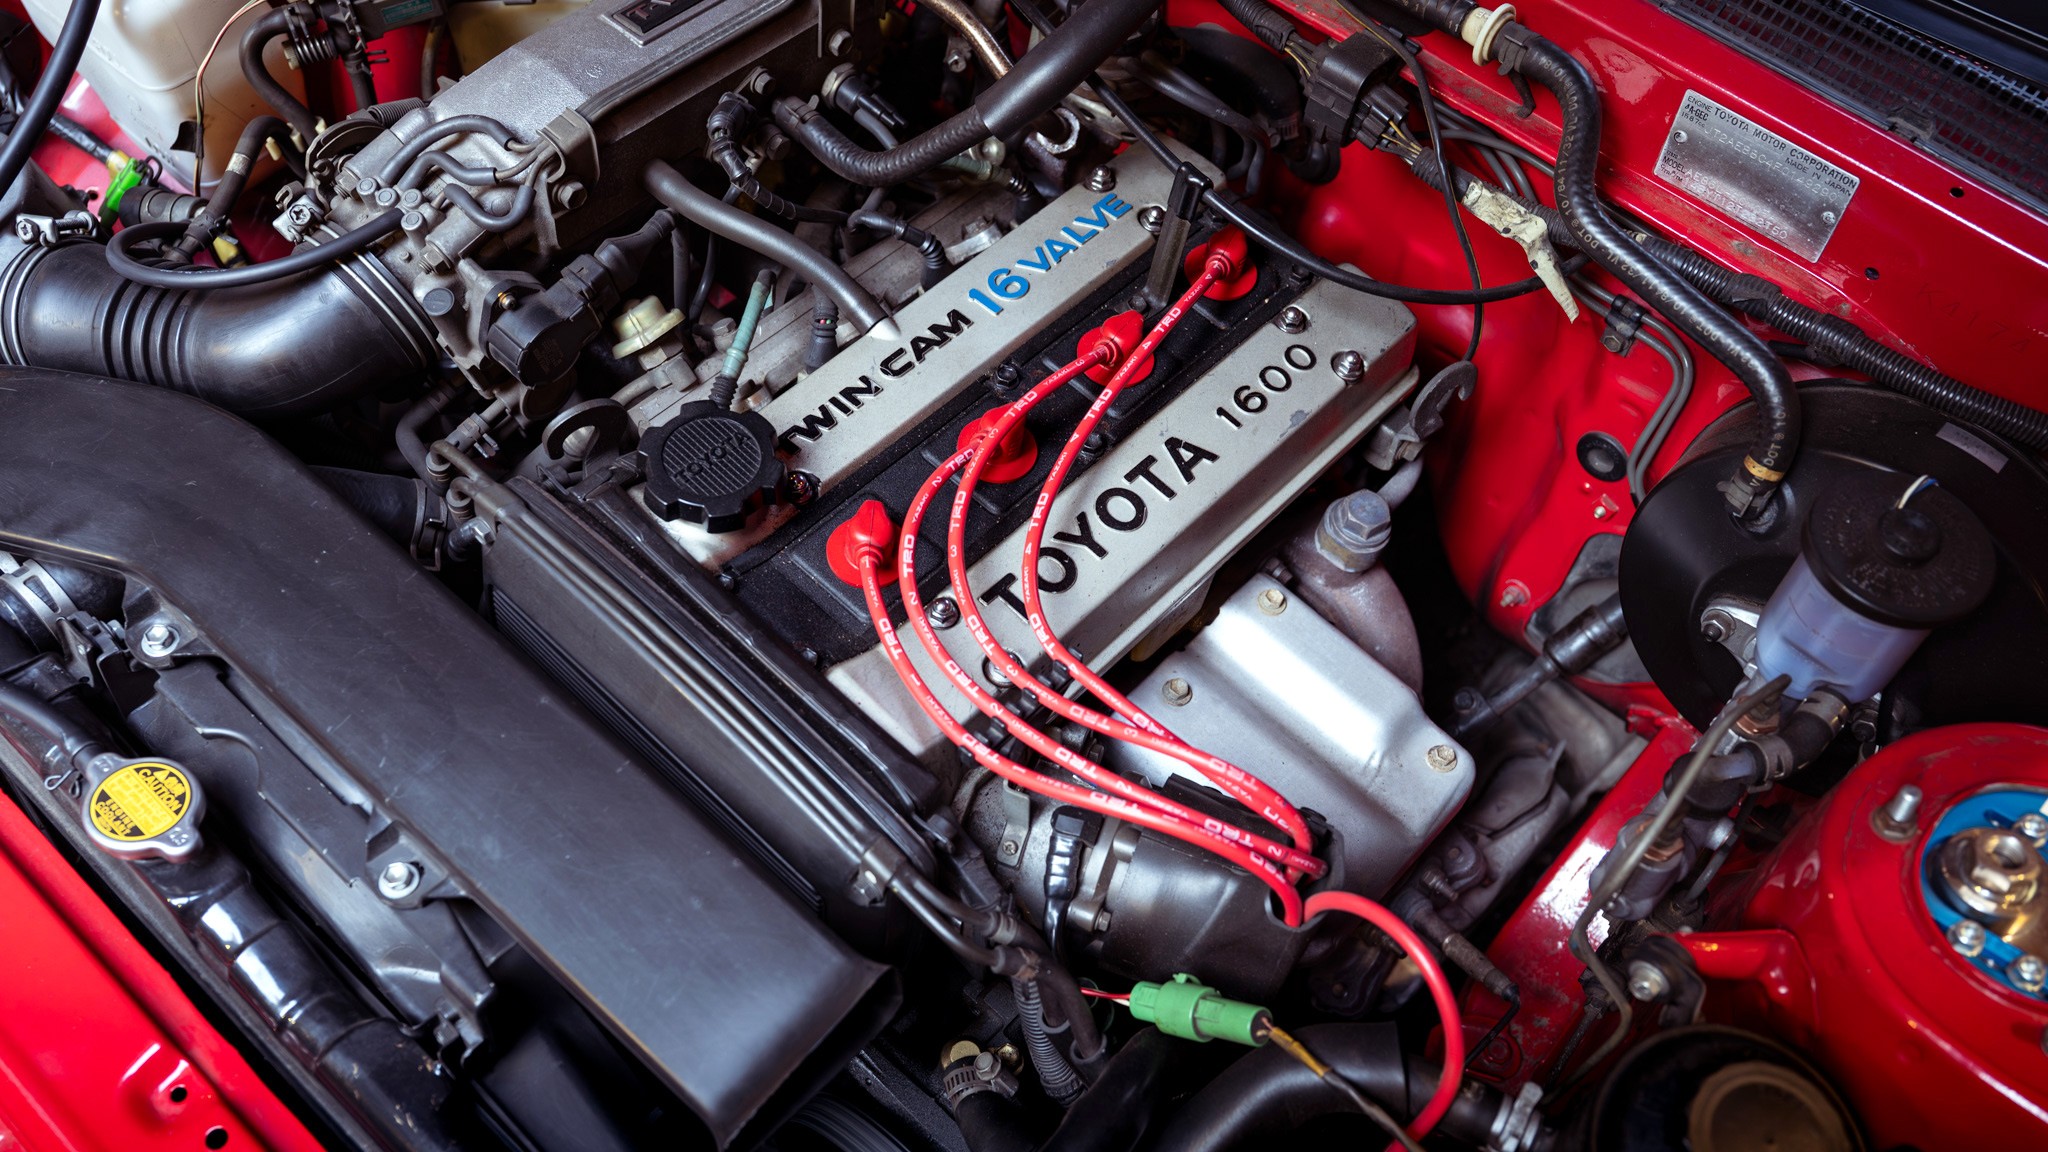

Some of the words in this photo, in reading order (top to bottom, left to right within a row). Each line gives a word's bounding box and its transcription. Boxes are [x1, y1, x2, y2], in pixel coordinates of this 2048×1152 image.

[1687, 95, 1713, 114] ENGINE
[1714, 107, 1750, 133] TOYOTA
[1752, 127, 1787, 152] MOTOR
[1789, 148, 1858, 190] CORPORATION
[1662, 156, 1686, 175] MODEL
[1785, 157, 1808, 175] MADE
[1811, 171, 1822, 181] IN
[1824, 178, 1852, 197] JAPAN
[1577, 229, 1600, 249] DOT
[968, 267, 1030, 316] 16
[1015, 192, 1135, 273] VALVE
[1183, 284, 1204, 302] YAZAKI
[1153, 307, 1182, 333] TRD
[1142, 340, 1152, 350] 4
[1075, 359, 1085, 367] 3
[1115, 355, 1138, 381] YAZAKI
[778, 375, 884, 456] TWIN
[880, 309, 975, 379] CAM
[1043, 368, 1070, 387] YAZAKI
[1216, 343, 1317, 430] 1600
[1003, 390, 1038, 417] TRD
[1083, 388, 1113, 420] TRD
[988, 428, 999, 439] 3
[1070, 432, 1080, 443] 4
[671, 431, 751, 487] TOYOTA
[945, 448, 976, 471] TRD
[965, 447, 985, 479] YAZAKI
[1048, 451, 1068, 482] YAZAKI
[1763, 443, 1783, 467] DOT
[931, 475, 943, 488] 2
[912, 493, 930, 524] YAZAKI
[949, 490, 967, 533] TRD
[1028, 492, 1050, 531] TRD
[978, 436, 1221, 624] TOYOTA
[903, 533, 915, 578] TRD
[950, 545, 957, 558] 3
[1025, 542, 1033, 555] 4
[867, 576, 880, 608] YAZAKI
[908, 591, 918, 605] 2
[953, 568, 967, 606] YAZAKI
[1023, 566, 1031, 603] YAZAKI
[878, 617, 903, 660] TRD
[918, 616, 940, 652] YAZAKI
[967, 614, 995, 656] TRD
[1029, 613, 1056, 656] TRD
[910, 673, 921, 686] 1
[945, 659, 981, 699] TRD
[1006, 664, 1019, 676] 3
[1068, 663, 1080, 675] 4
[1026, 681, 1059, 705] YAZAKI
[926, 695, 954, 727] YAZAKI
[990, 702, 1004, 715] 2
[1069, 704, 1111, 731] TRD
[1012, 719, 1046, 745] YAZAKI
[1124, 727, 1138, 738] 3
[962, 733, 1001, 764] TRD
[1012, 765, 1027, 774] 1
[1054, 746, 1098, 780] TRD
[1209, 757, 1260, 792] TRD
[138, 768, 183, 812] CAUTION
[1116, 780, 1133, 794] 2
[1203, 818, 1255, 848] TRD
[1267, 844, 1283, 857] 2
